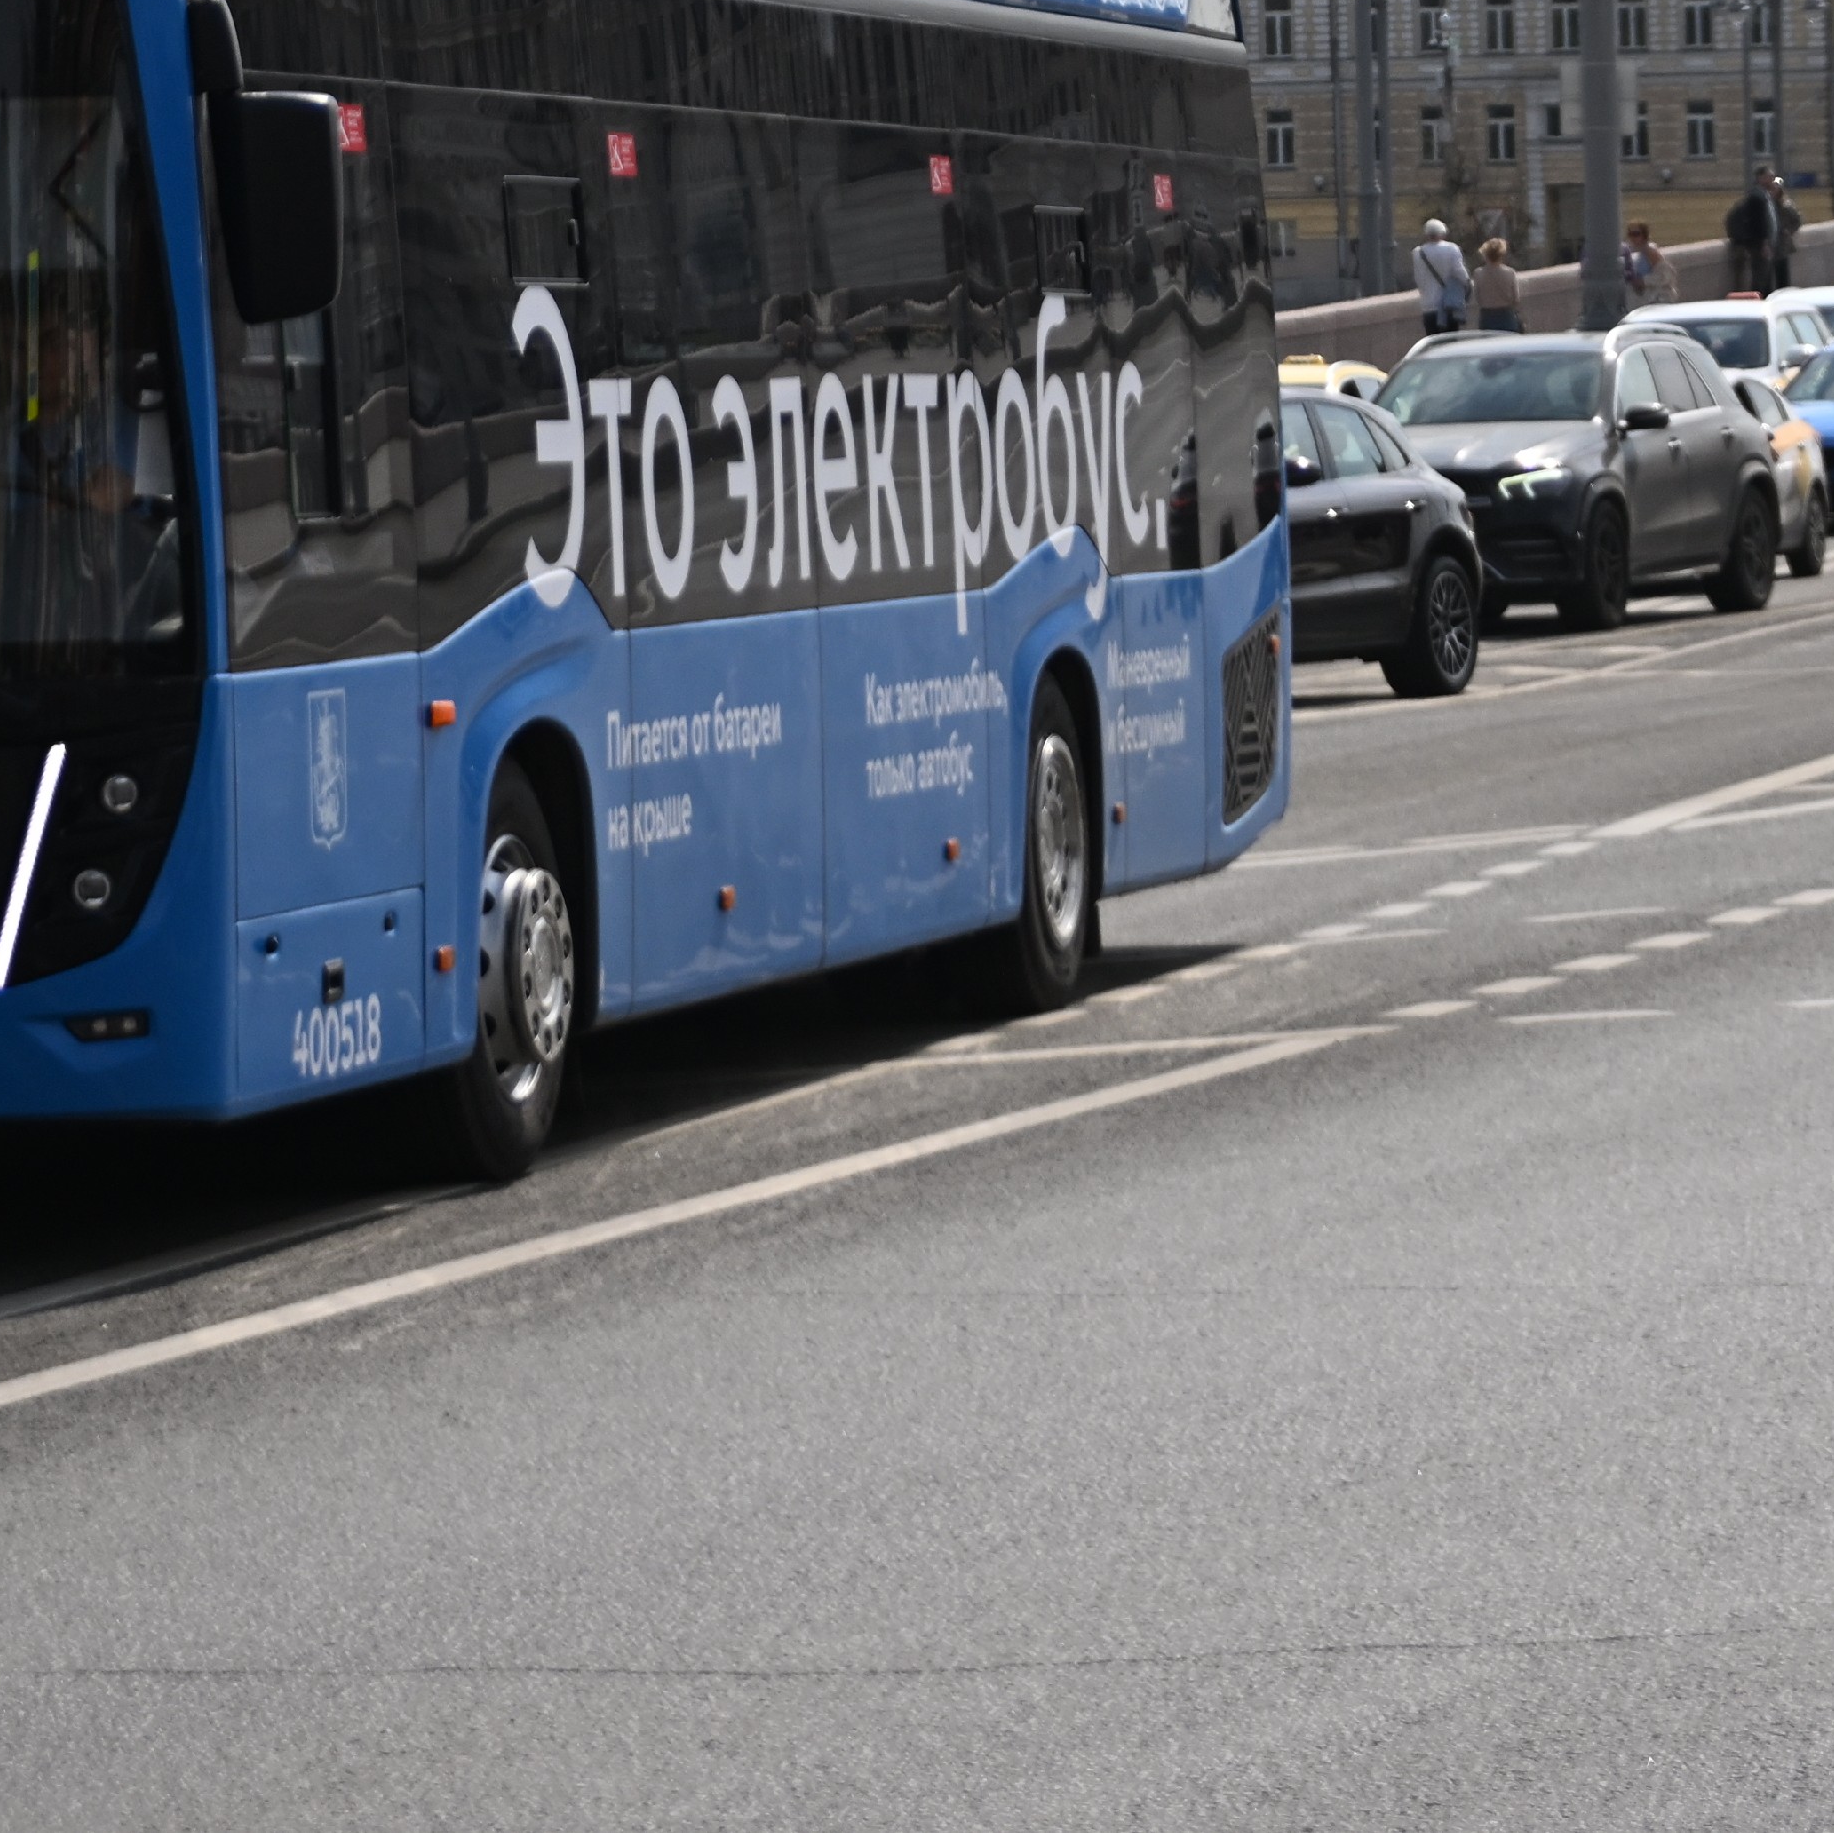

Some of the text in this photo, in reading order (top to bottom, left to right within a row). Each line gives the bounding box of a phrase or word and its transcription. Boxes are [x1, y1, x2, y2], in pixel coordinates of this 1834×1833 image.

[511, 285, 1168, 636] Это электробус.
[607, 690, 783, 770] Питается от батареи
[866, 671, 894, 725] Как
[866, 730, 974, 799] только автобус
[607, 793, 693, 857] на крыше
[293, 991, 382, 1078] 400518
